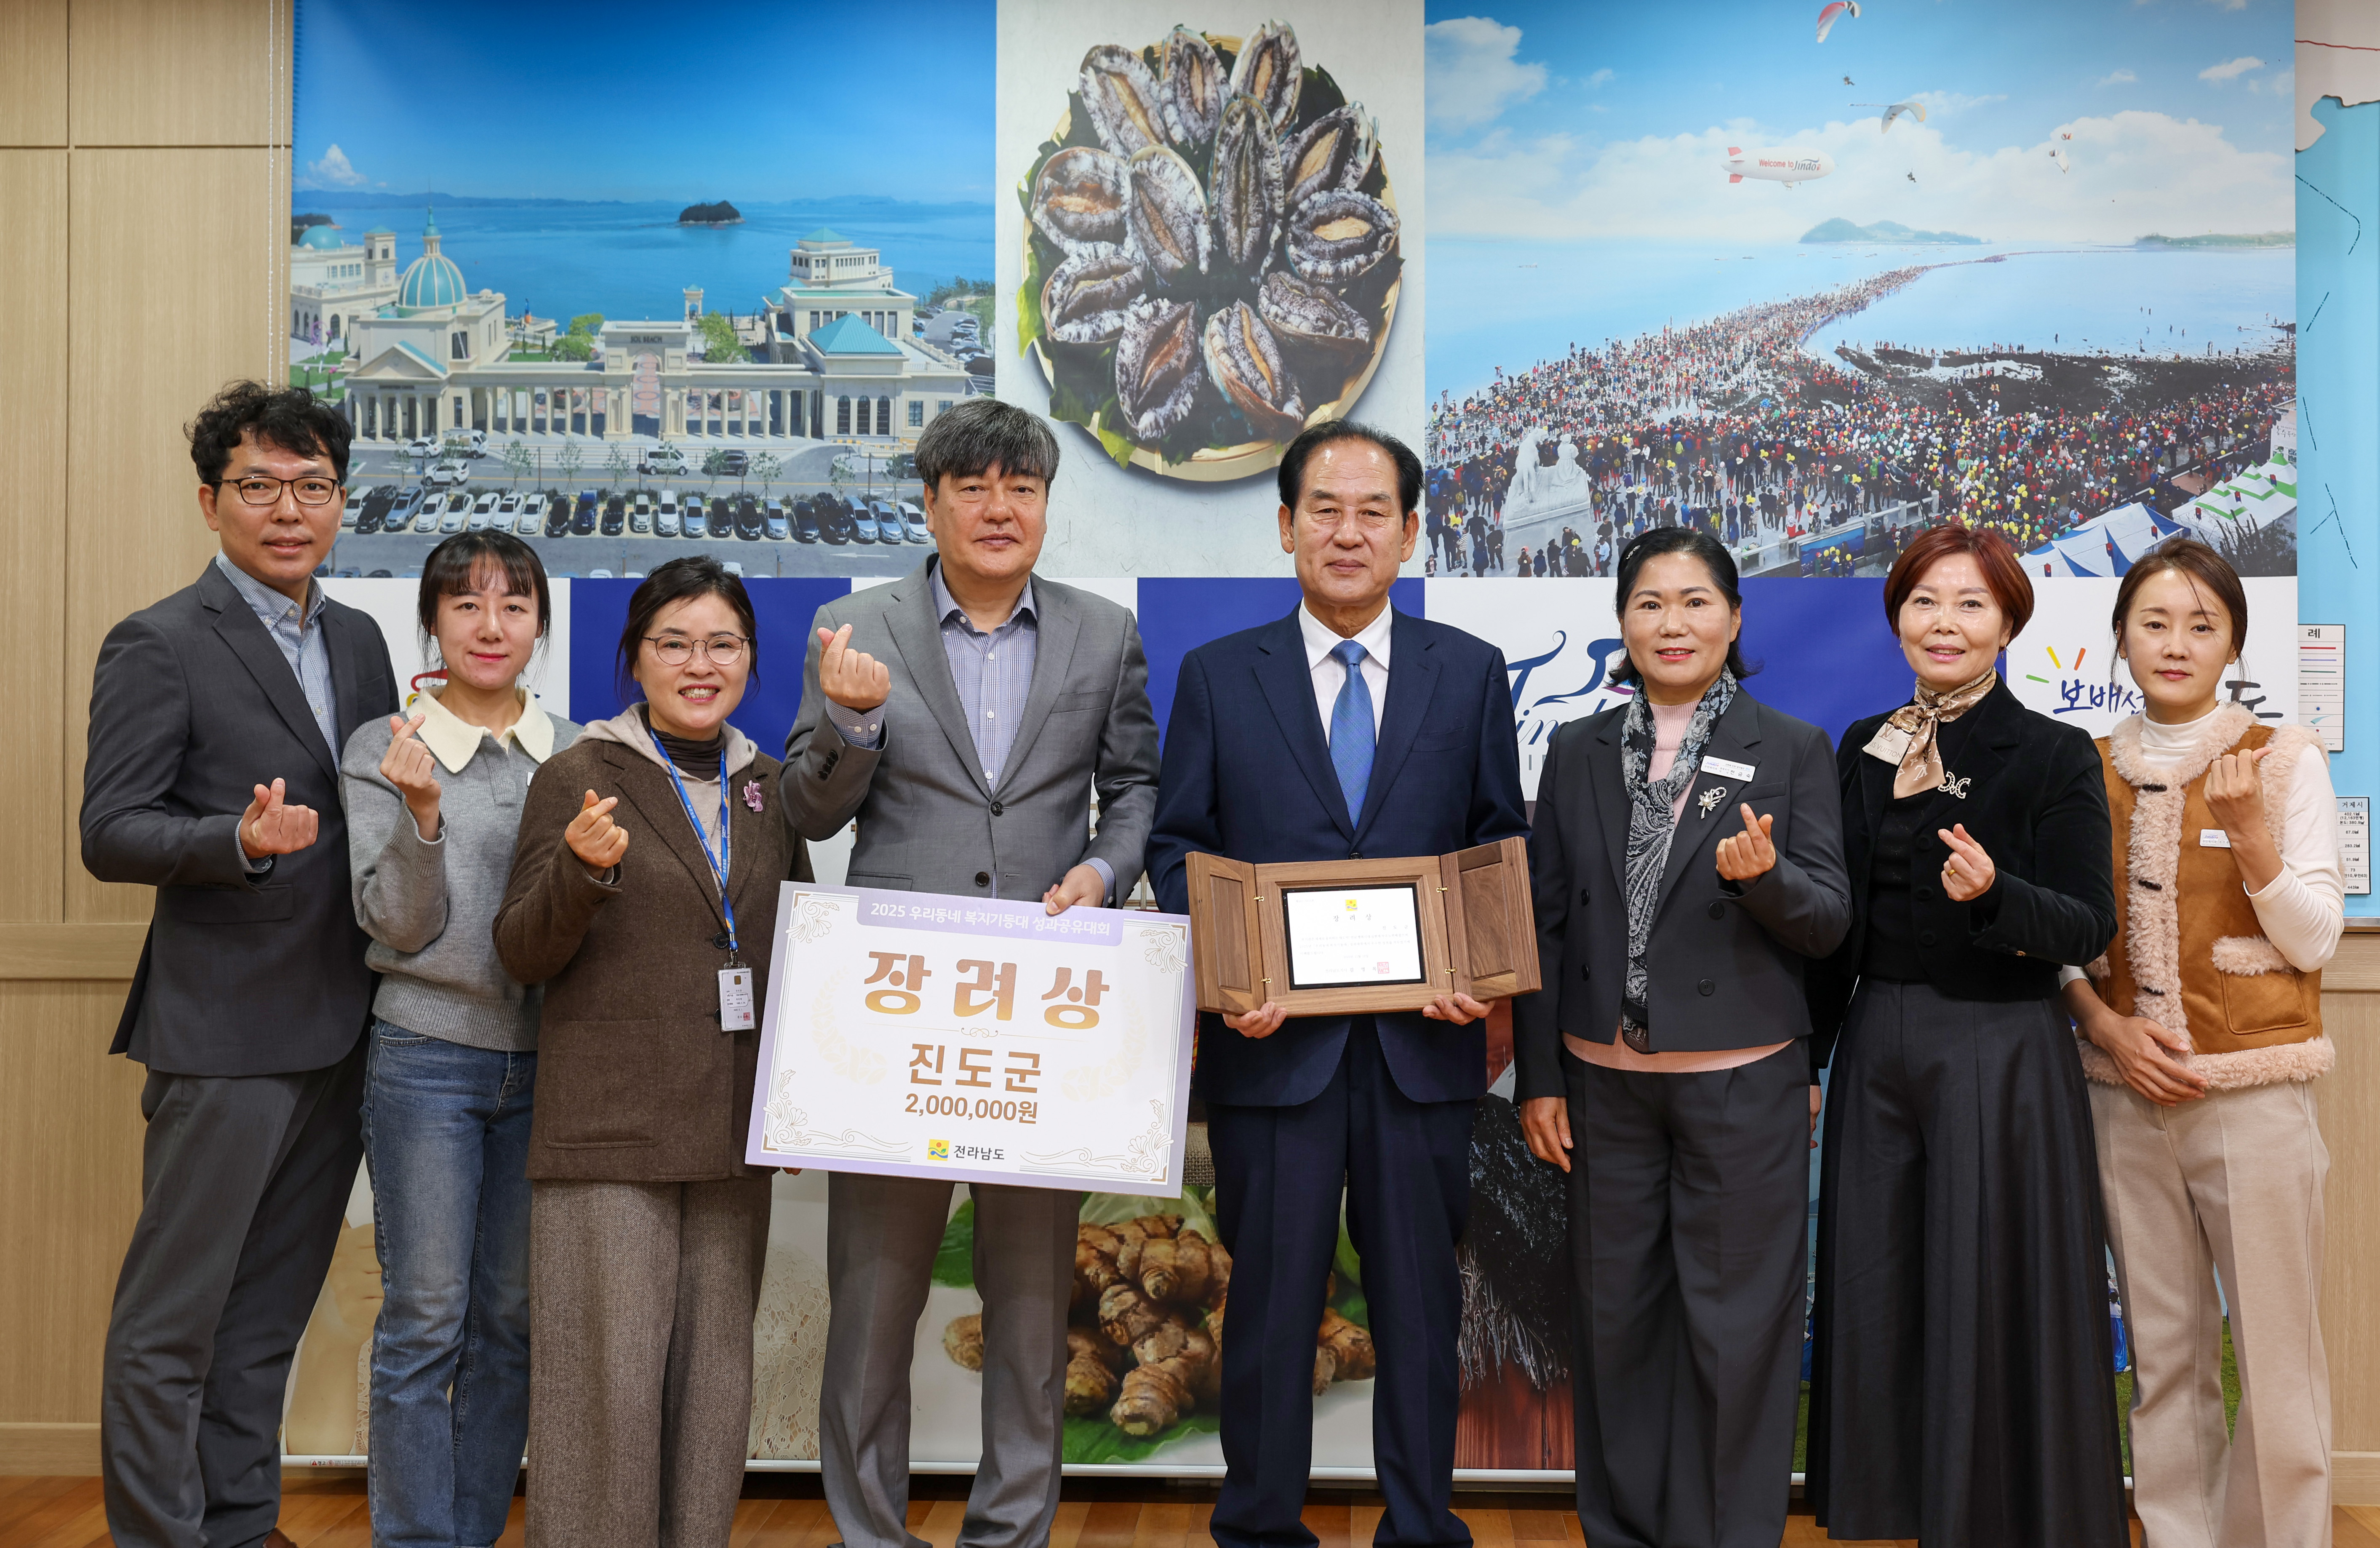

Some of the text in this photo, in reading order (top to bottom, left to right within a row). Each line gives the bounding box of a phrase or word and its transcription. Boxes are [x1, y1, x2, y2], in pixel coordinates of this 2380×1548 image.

[1758, 158, 1817, 171] Welcome to Jindo
[1878, 744, 1903, 758] VUITTON
[871, 903, 1110, 936] 2025 우리동네 복지기동대 성과공유대회
[909, 1044, 1041, 1093] 진도군
[905, 1093, 1038, 1125] 2,000,000원
[954, 1145, 1004, 1161] 전라남도
